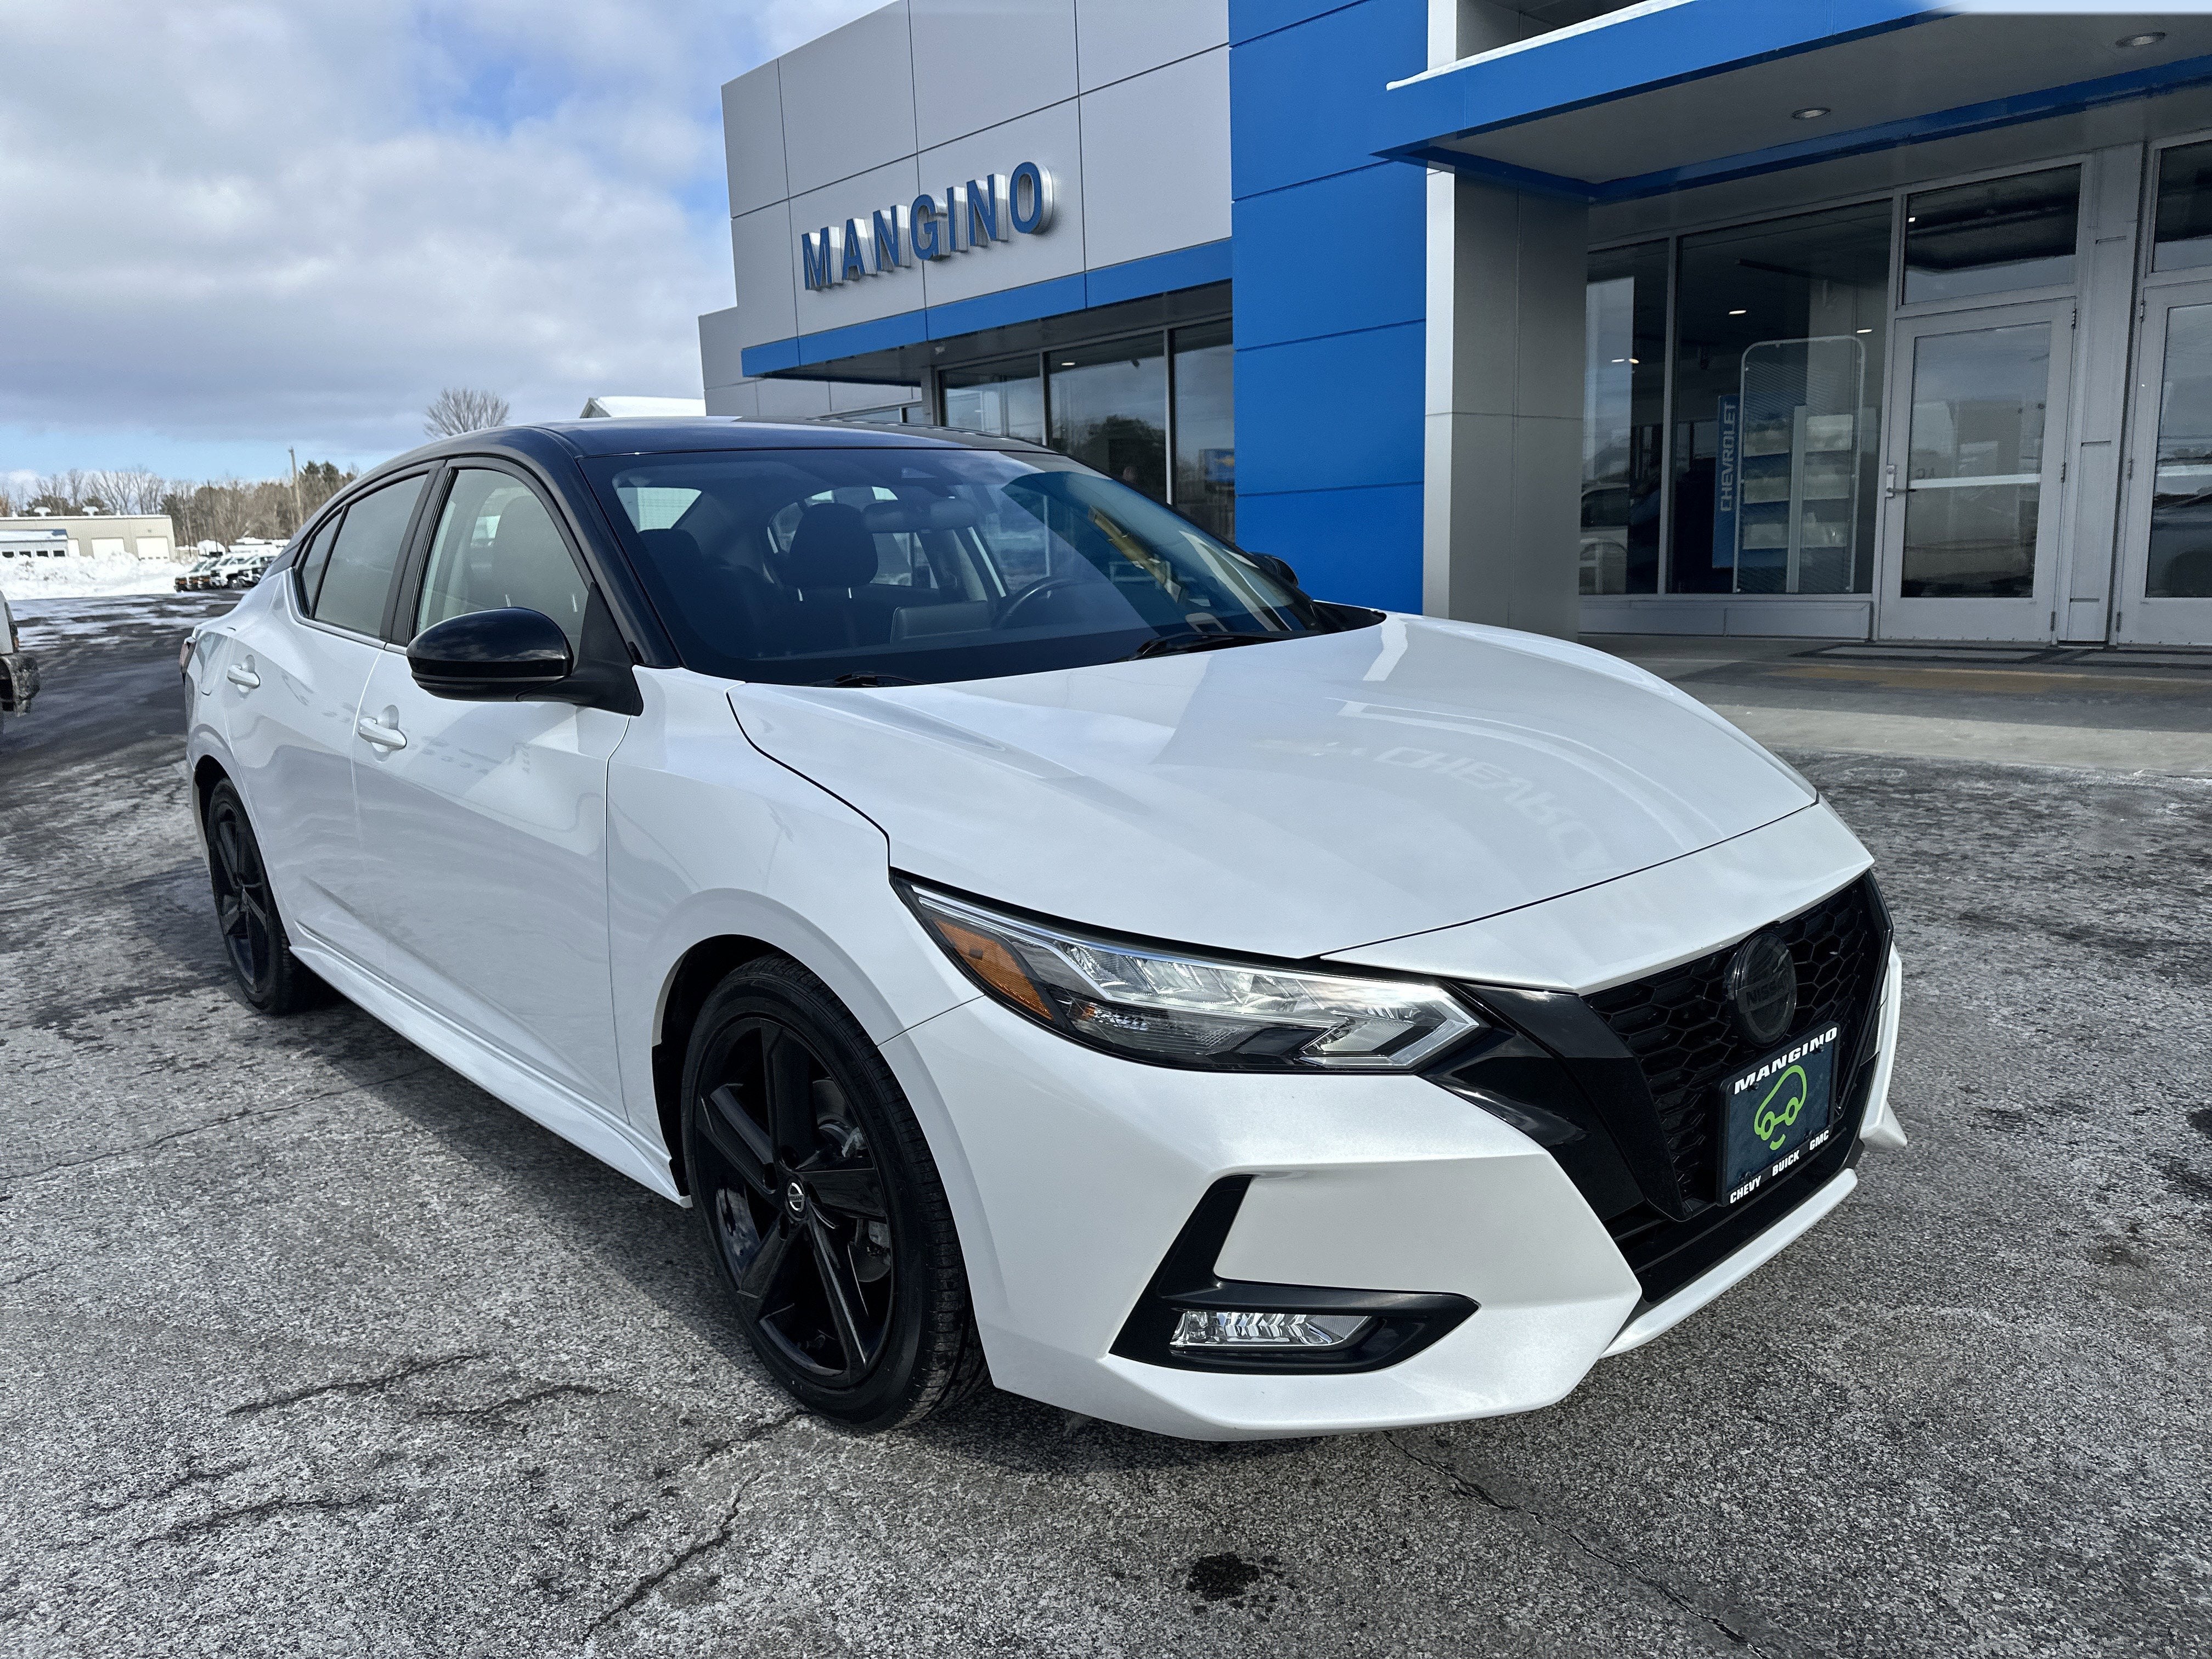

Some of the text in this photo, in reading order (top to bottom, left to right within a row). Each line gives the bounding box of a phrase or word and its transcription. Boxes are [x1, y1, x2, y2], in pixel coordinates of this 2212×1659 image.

[802, 161, 1053, 291] MANGINO
[1720, 399, 1736, 512] CHEVROLET
[1734, 1027, 1837, 1095] MANGINO
[1730, 1130, 1829, 1204] CHEVY BUICK GMC
